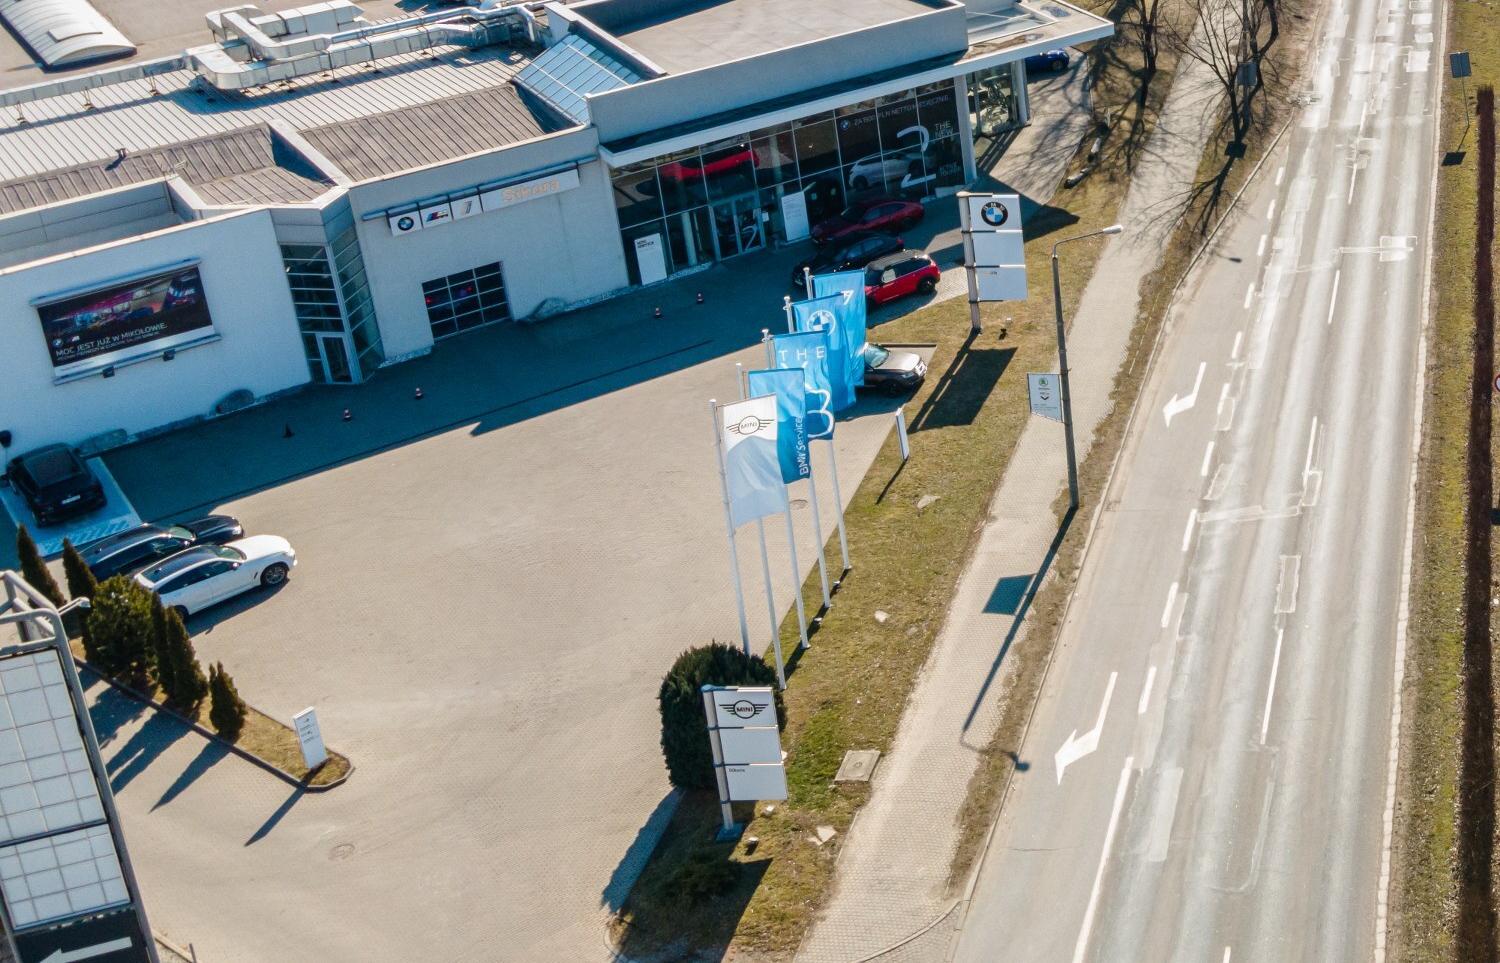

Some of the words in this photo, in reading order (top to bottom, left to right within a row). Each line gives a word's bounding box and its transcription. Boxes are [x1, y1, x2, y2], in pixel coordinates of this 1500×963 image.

[56, 345, 74, 356] MOC
[77, 340, 95, 352] JEST
[97, 336, 111, 347] JUŻ
[112, 335, 120, 343] W
[778, 346, 825, 362] THE
[741, 422, 758, 430] MINI
[795, 417, 806, 451] Service
[797, 451, 808, 475] BMW
